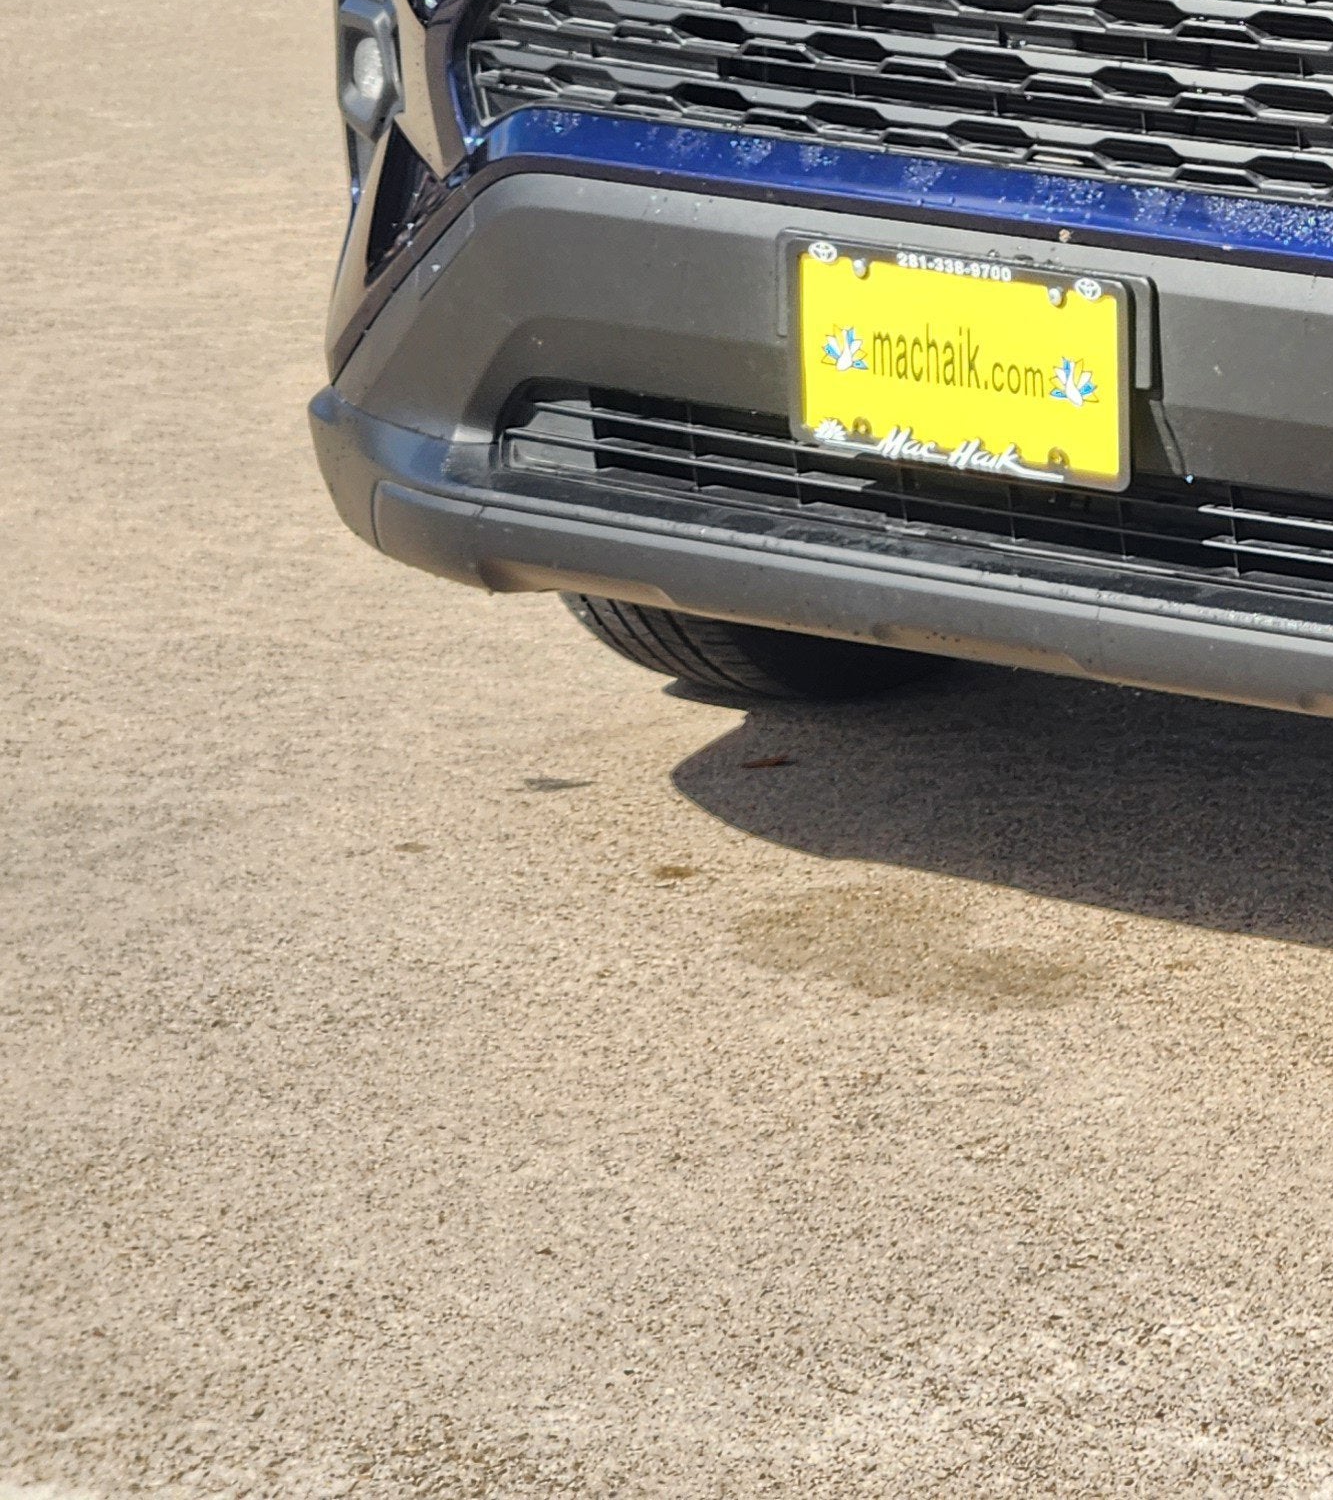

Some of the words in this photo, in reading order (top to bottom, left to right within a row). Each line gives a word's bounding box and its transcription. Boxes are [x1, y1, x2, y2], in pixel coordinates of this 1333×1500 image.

[896, 252, 1012, 282] 281-338-9700
[872, 322, 1045, 399] machaik.com
[877, 425, 942, 461] Mac
[949, 436, 1030, 473] Haik
